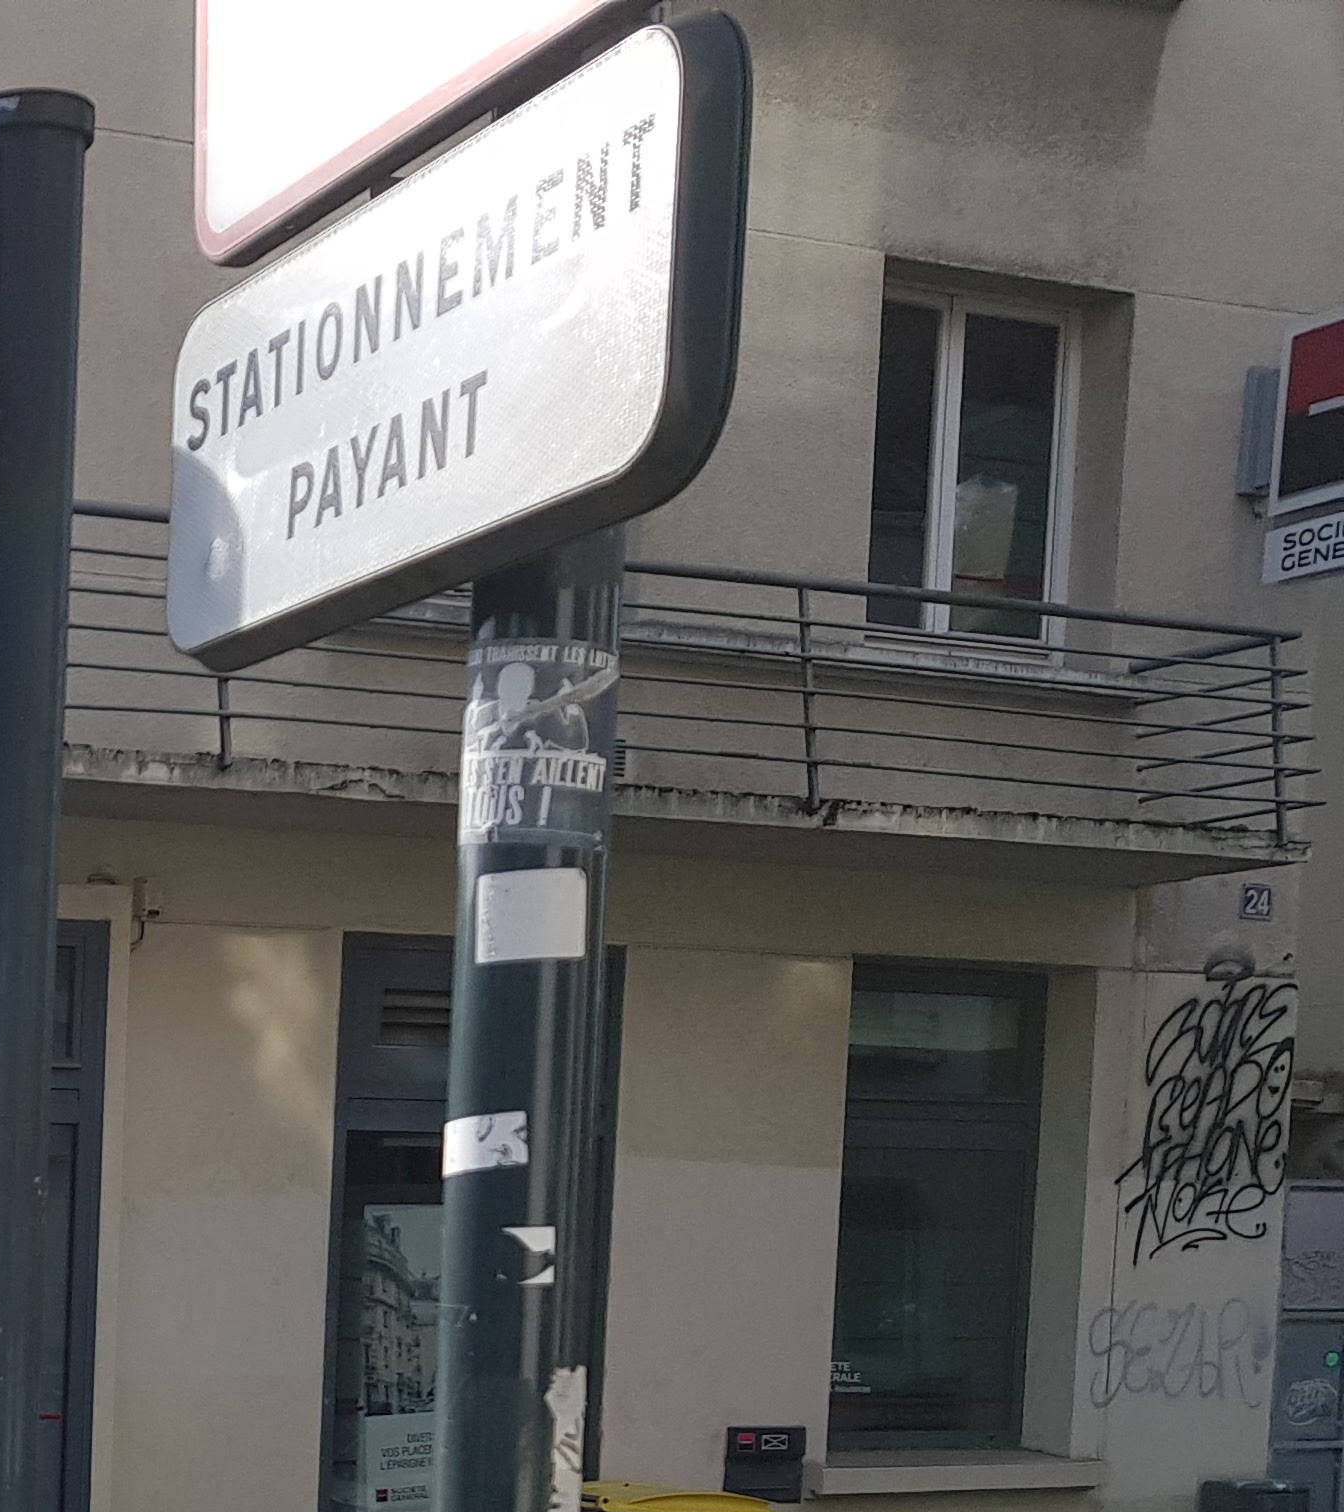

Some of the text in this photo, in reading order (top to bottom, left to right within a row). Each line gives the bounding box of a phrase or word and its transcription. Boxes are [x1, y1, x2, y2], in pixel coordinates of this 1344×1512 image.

[187, 113, 656, 452] STATIONNEMENT
[287, 369, 489, 540] PAYANT
[1282, 521, 1344, 551] SOCI
[530, 757, 605, 792] AILLENT
[466, 785, 525, 826] TOUS
[1245, 889, 1269, 915] 24
